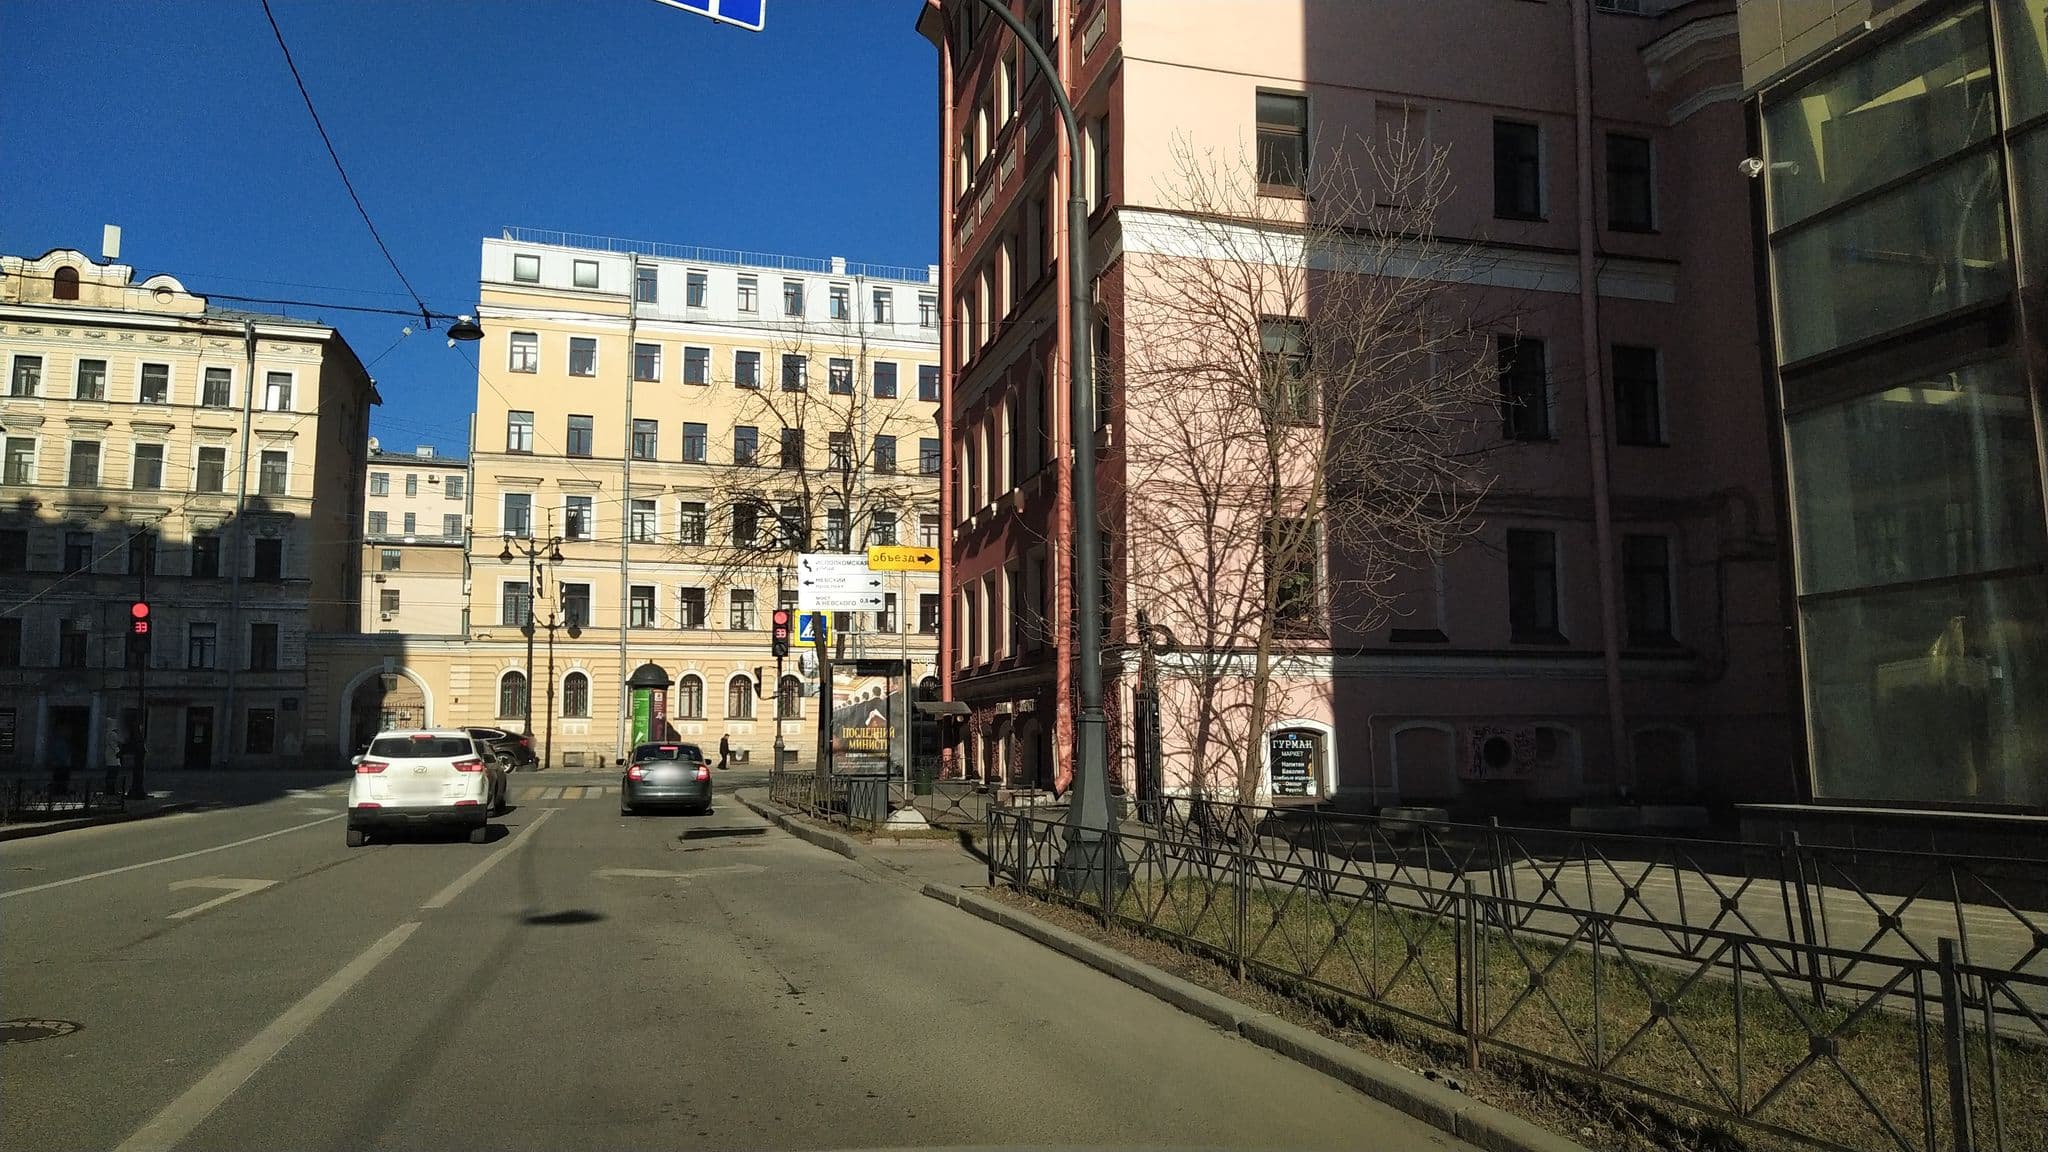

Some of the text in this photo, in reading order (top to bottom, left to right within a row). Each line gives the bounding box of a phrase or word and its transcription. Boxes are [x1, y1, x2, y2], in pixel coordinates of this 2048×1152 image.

[873, 552, 915, 563] объезд
[135, 621, 148, 633] 33
[1272, 740, 1313, 749] ГУРМАН
